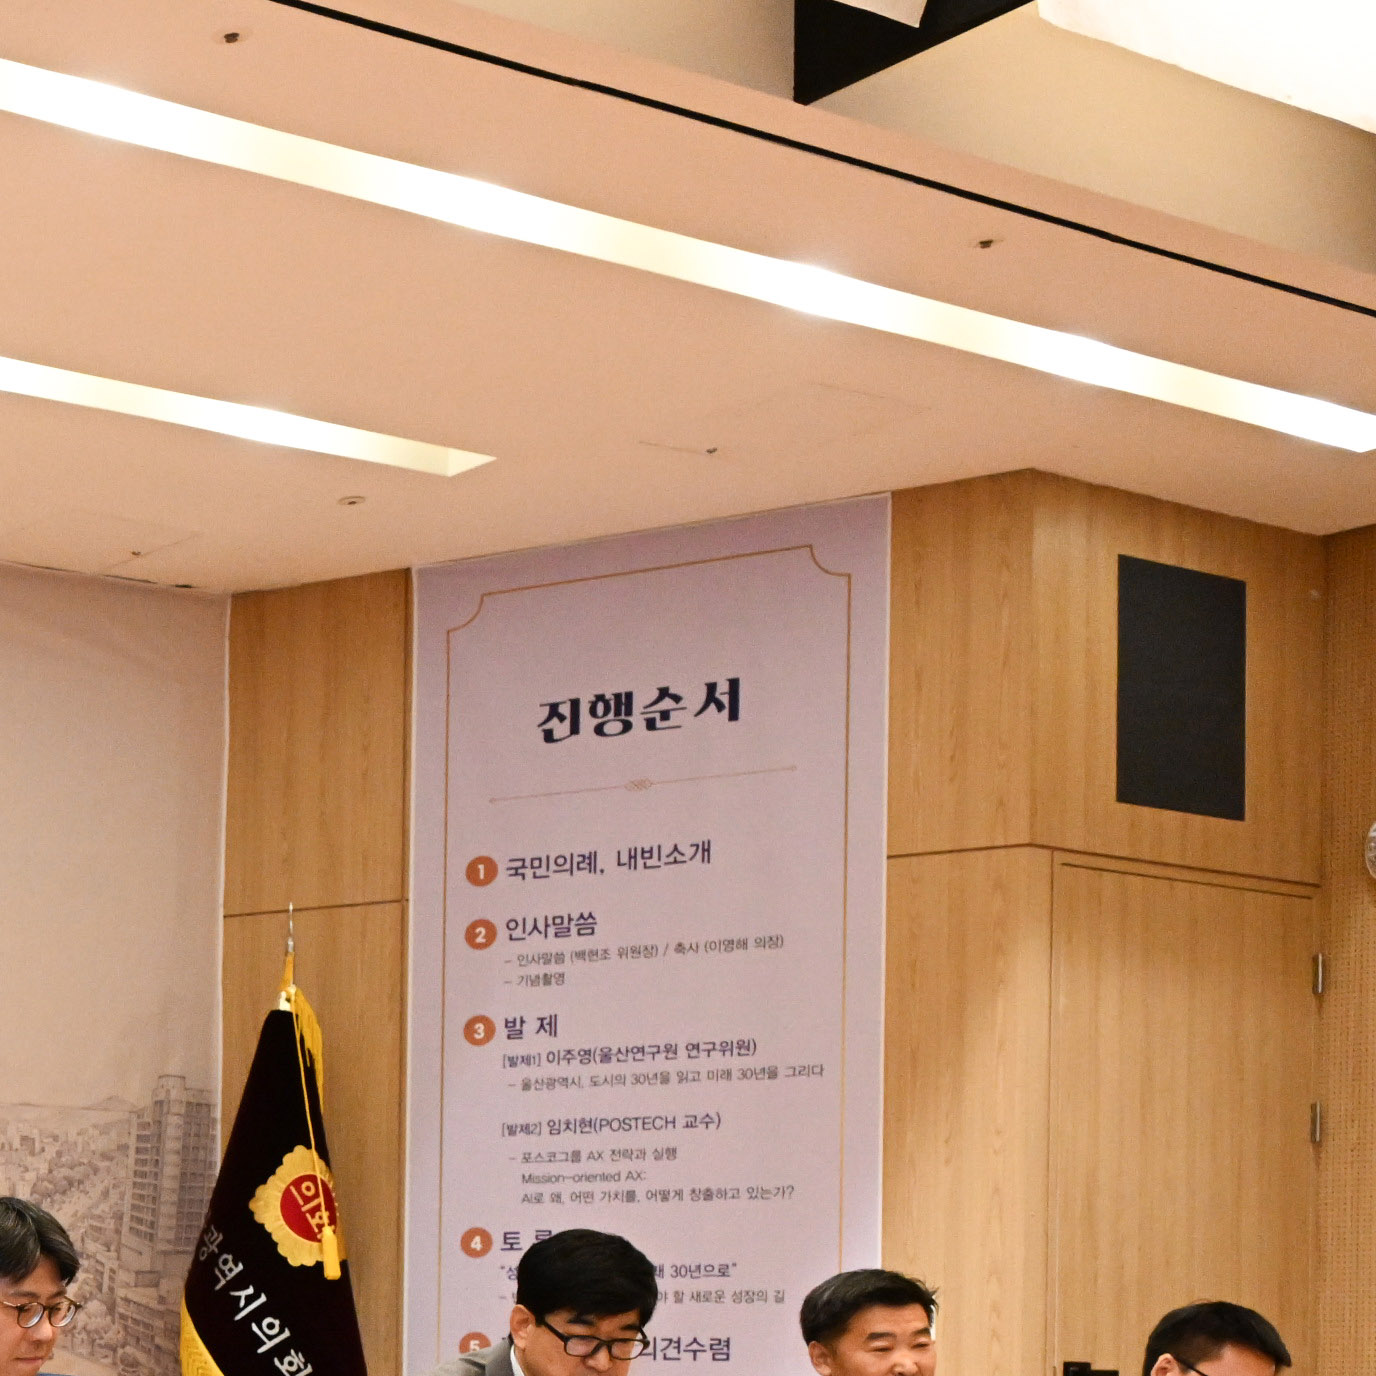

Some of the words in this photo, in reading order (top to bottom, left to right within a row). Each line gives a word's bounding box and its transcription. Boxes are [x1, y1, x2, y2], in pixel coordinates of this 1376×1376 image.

[537, 677, 740, 745] 진행순서
[617, 840, 712, 872] 내빈소개
[475, 927, 487, 943] 2
[505, 911, 598, 942] 인사말씀
[517, 952, 566, 968] 인사말씀
[617, 943, 659, 960] 위원장)
[704, 937, 748, 954] (이영해
[516, 972, 566, 988] 기념촬영
[474, 1023, 484, 1039] 3
[546, 1042, 678, 1065] 이주영(울산연구원
[685, 1038, 757, 1060] 연구위원)
[590, 1074, 626, 1088] 도시의
[631, 1071, 670, 1086] 30년을
[677, 1070, 701, 1084] 읽고
[707, 1068, 732, 1083] 미래
[737, 1065, 778, 1081] 30년을
[785, 1063, 824, 1078] 그리다
[683, 1111, 721, 1131] 교수)
[521, 1149, 581, 1164] 포스코그룹
[586, 1150, 604, 1161] AX
[610, 1147, 646, 1162] 전략과
[652, 1147, 677, 1161] 실행
[521, 1191, 544, 1205] AI로
[570, 1190, 594, 1204] 어떤
[646, 1187, 683, 1202] 어떻게
[690, 1186, 740, 1202] 창출하고
[747, 1184, 795, 1200] 있는가?
[470, 1235, 483, 1251] 4
[673, 1290, 685, 1304] 할
[690, 1289, 725, 1304] 새로운
[731, 1289, 768, 1304] 성장의
[774, 1289, 785, 1304] 길
